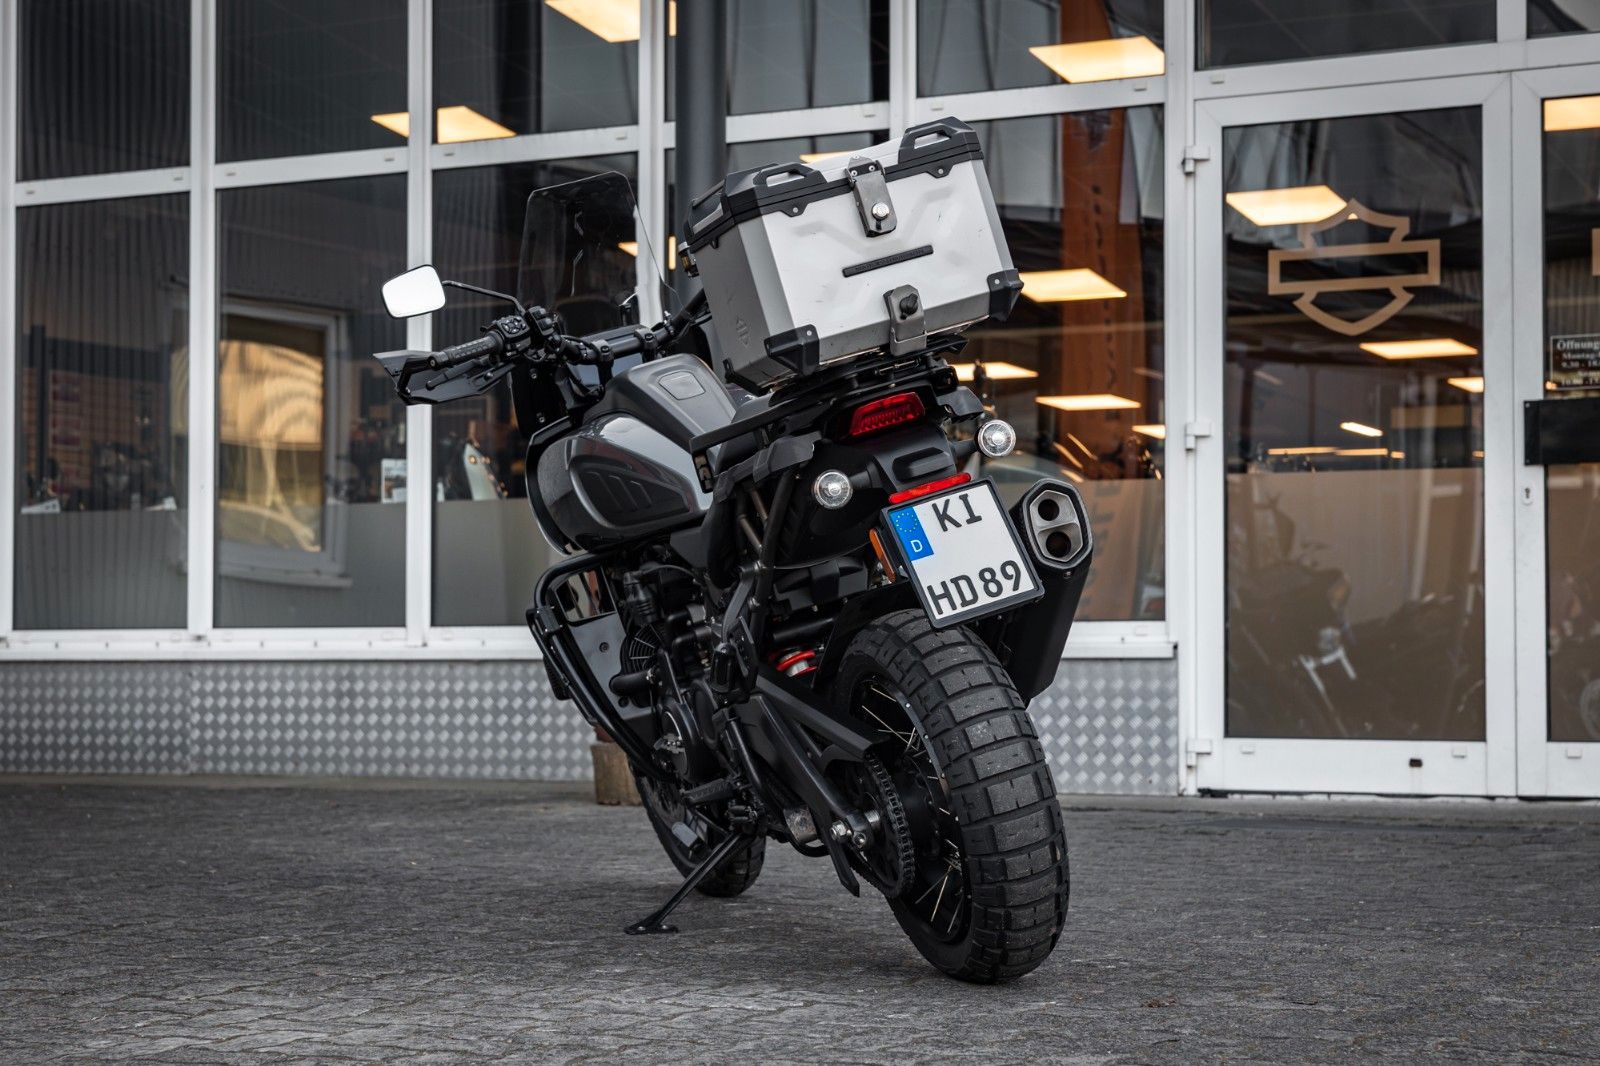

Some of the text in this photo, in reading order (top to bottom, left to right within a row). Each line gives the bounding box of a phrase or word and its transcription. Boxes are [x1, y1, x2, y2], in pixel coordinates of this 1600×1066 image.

[931, 493, 982, 532] KI
[910, 539, 924, 552] D
[926, 560, 1022, 615] HD 89
